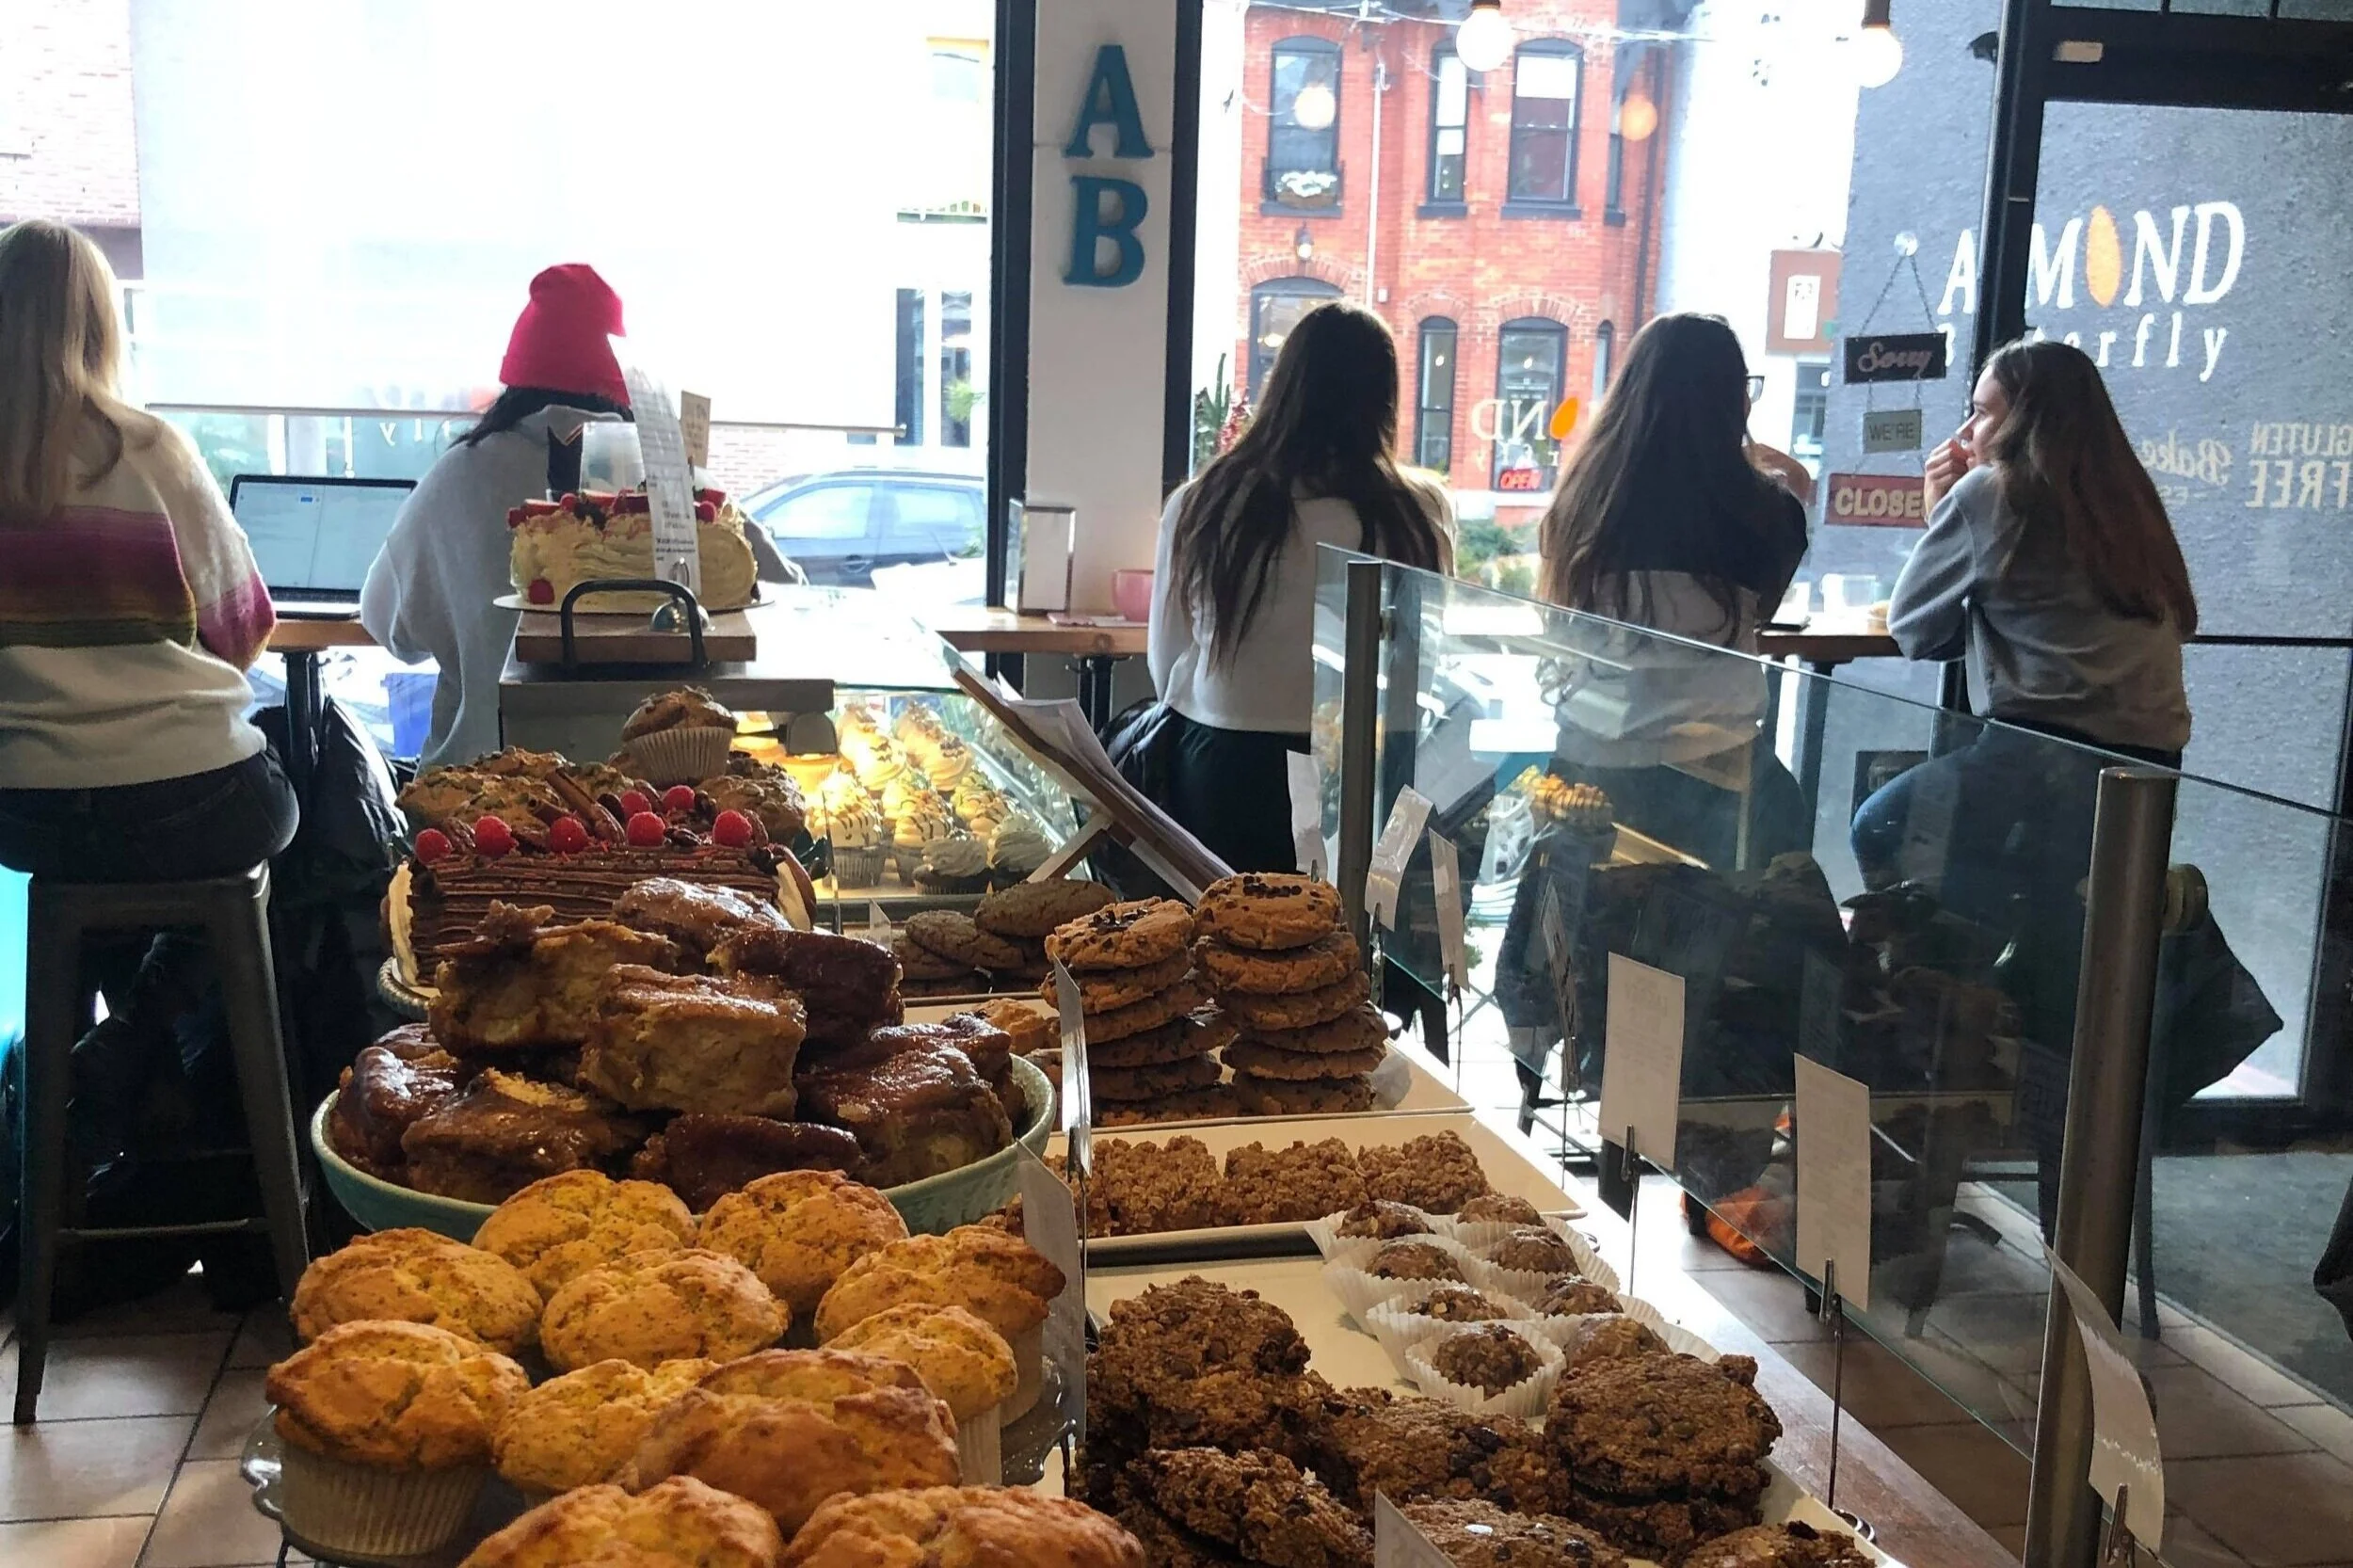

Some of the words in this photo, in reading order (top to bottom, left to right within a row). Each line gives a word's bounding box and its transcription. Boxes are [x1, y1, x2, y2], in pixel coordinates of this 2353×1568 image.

[1937, 200, 2247, 316] AMOND
[1857, 341, 1933, 379] Sorry
[1867, 422, 1915, 441] WE'RE
[1834, 487, 1926, 519] CLOSE
